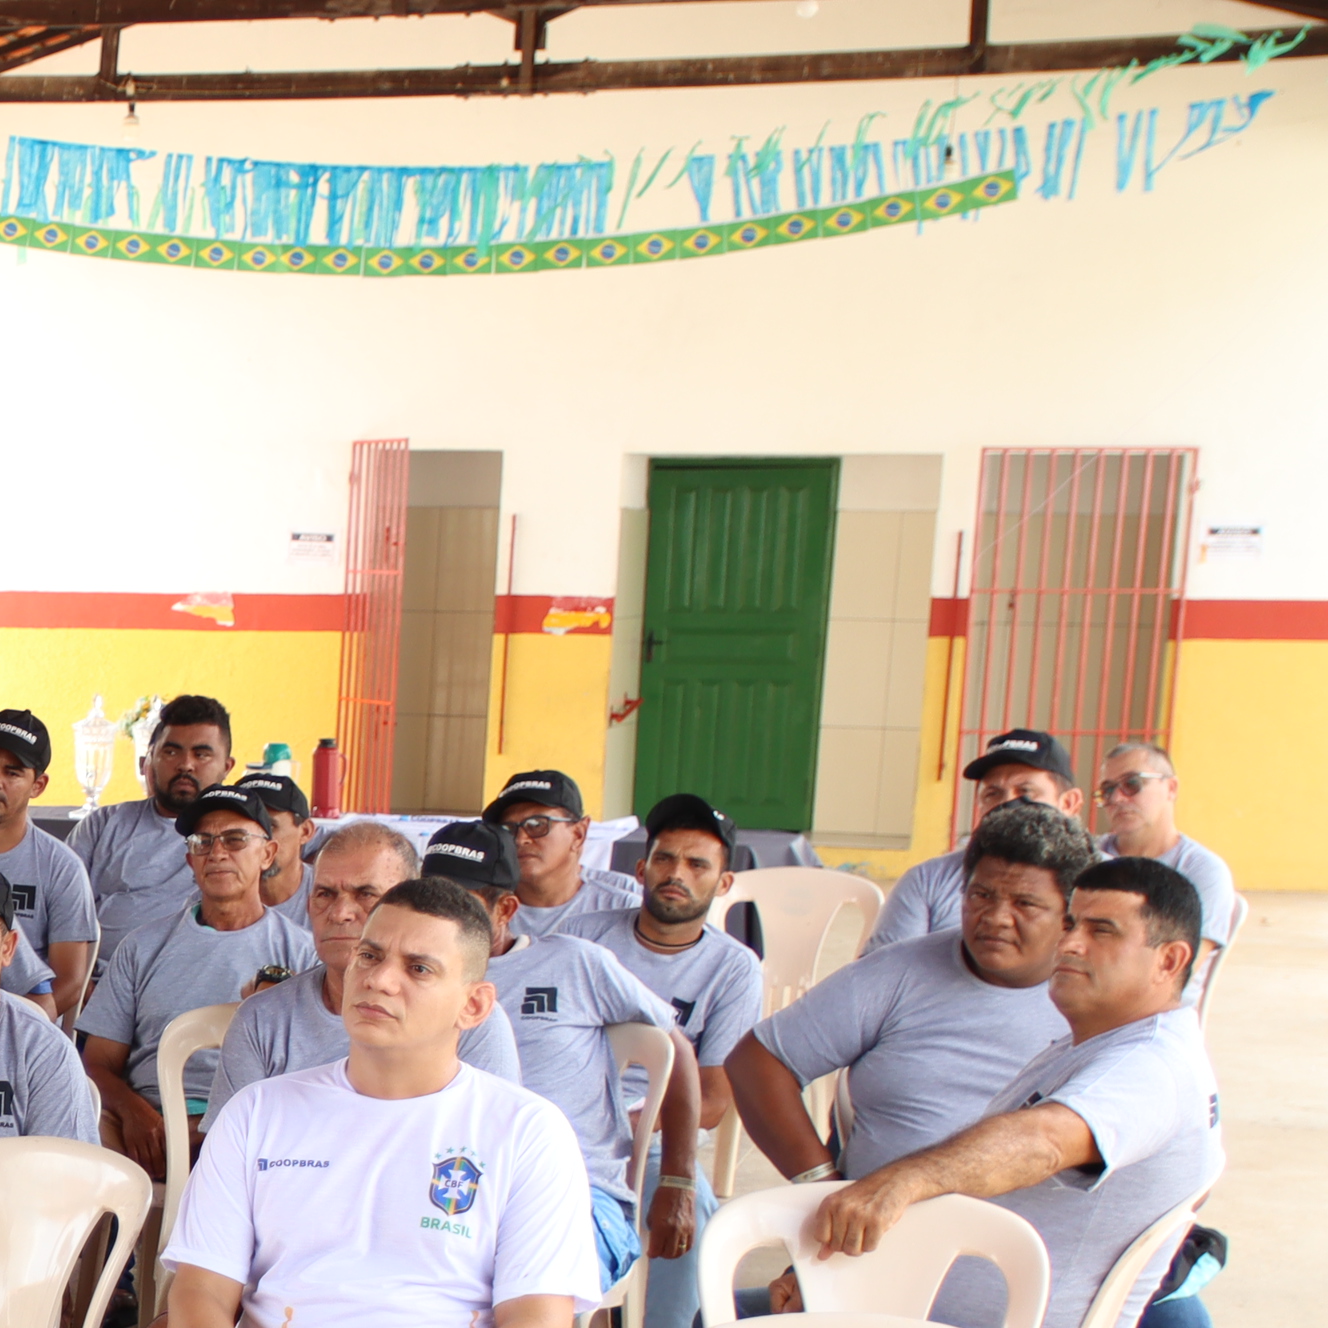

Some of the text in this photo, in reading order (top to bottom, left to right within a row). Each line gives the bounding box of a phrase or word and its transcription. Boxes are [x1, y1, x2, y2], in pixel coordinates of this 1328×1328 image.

[431, 843, 485, 861] COOPBRAS
[269, 1159, 330, 1168] COOPBRAS
[444, 1179, 464, 1189] CBF
[421, 1216, 472, 1239] BRASIL
